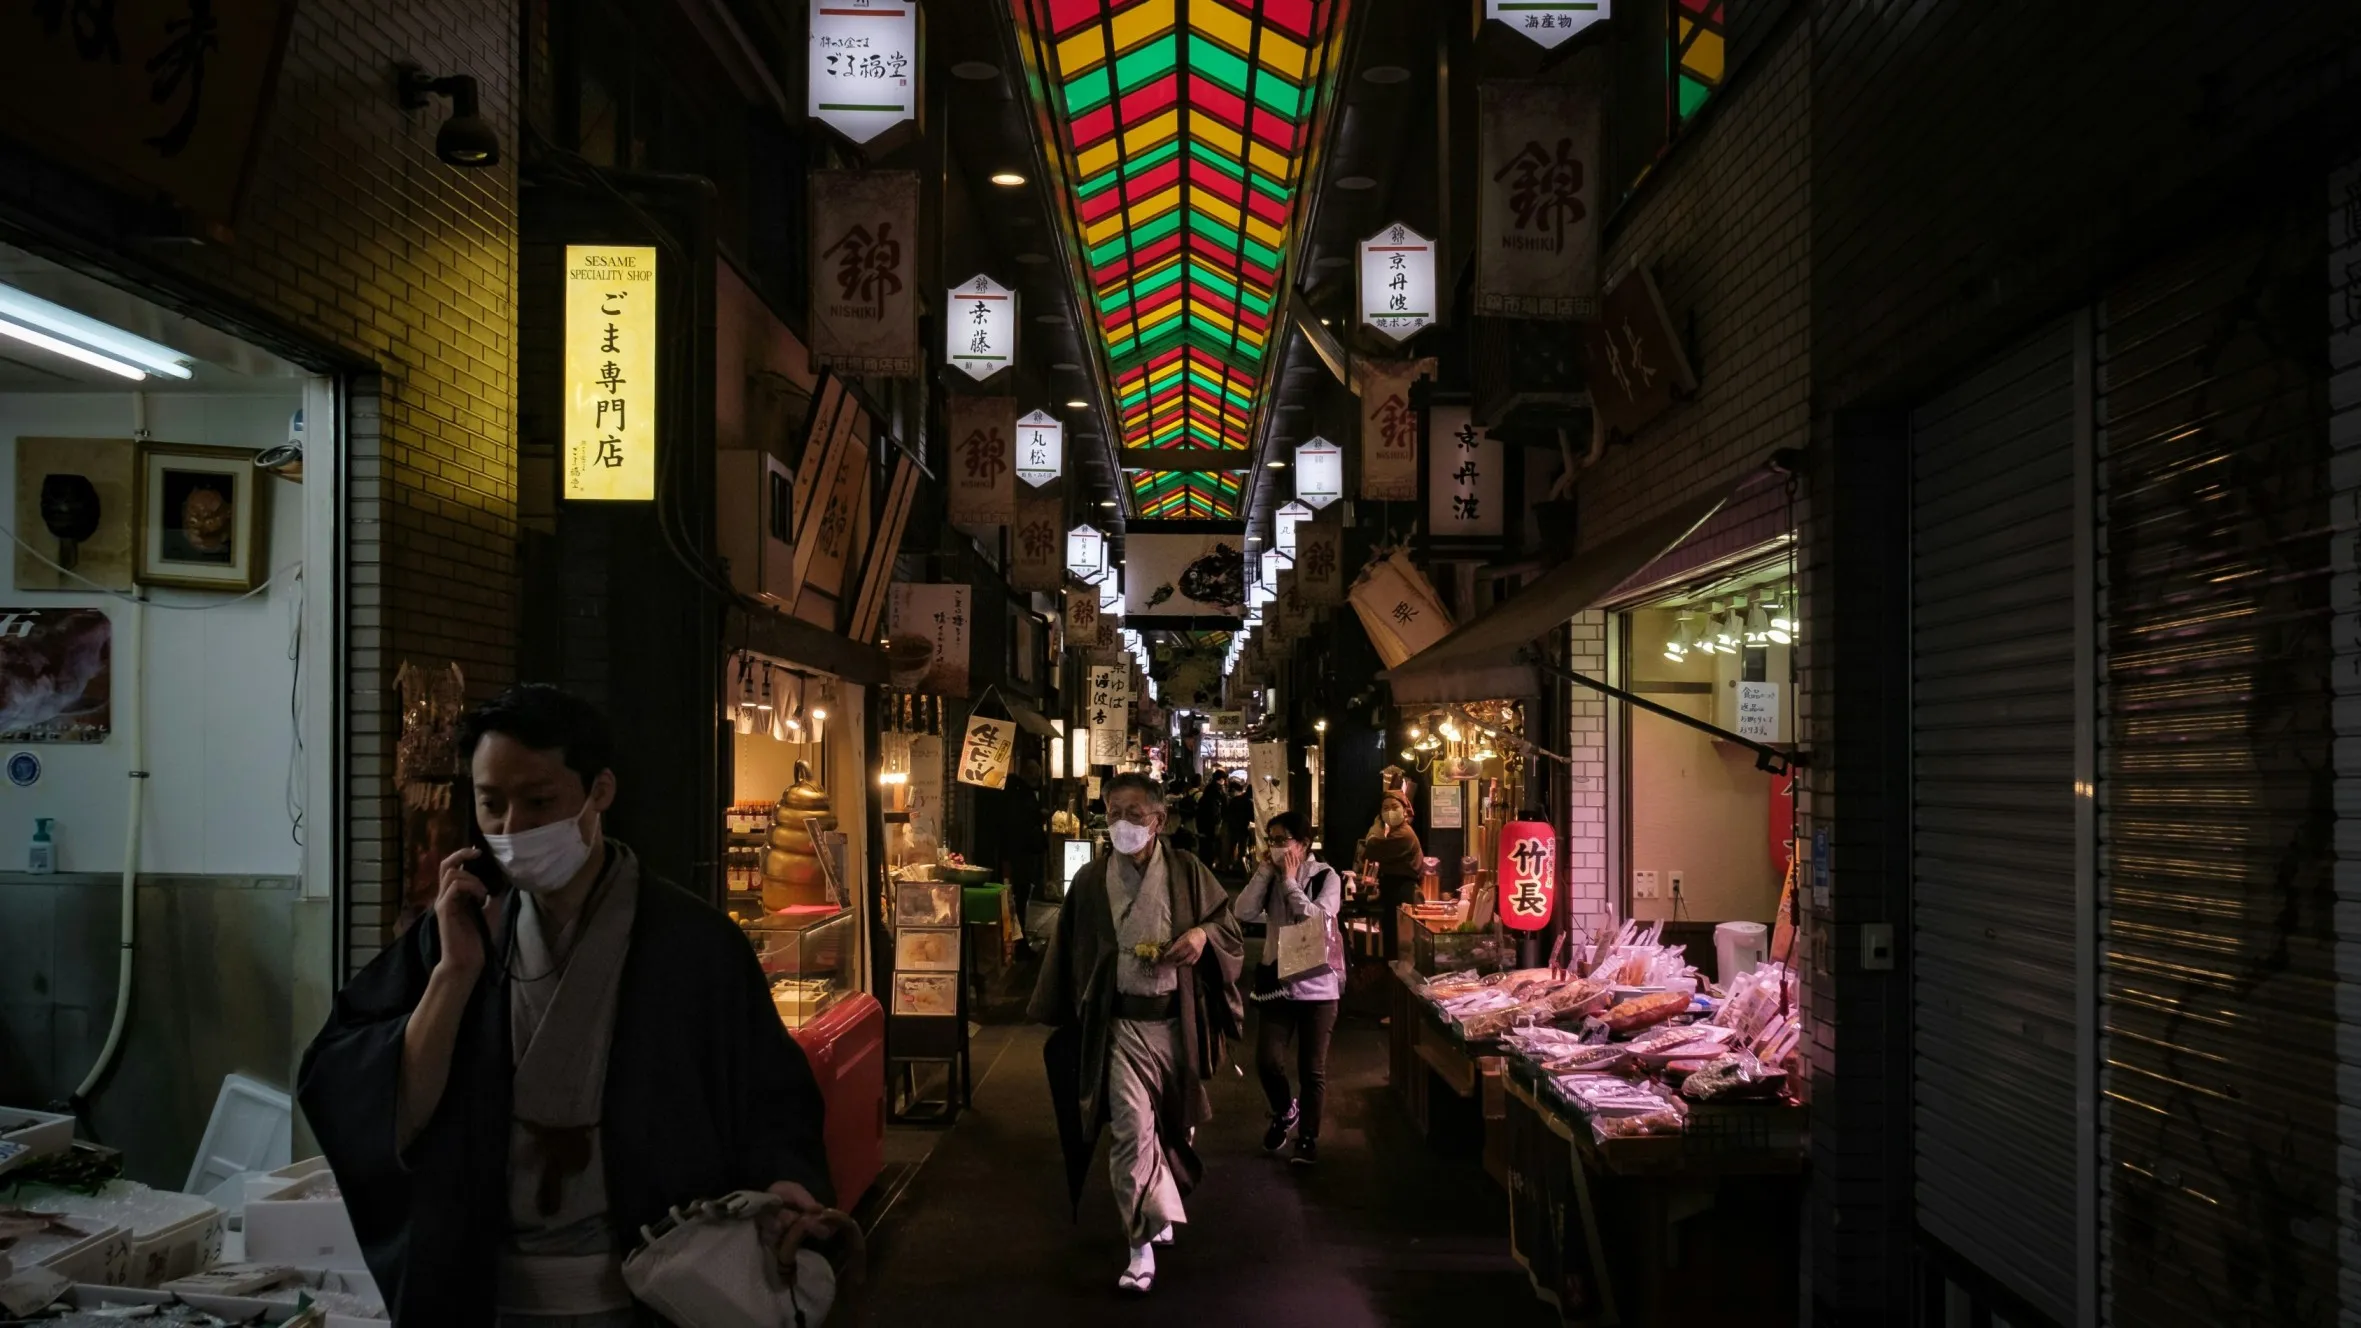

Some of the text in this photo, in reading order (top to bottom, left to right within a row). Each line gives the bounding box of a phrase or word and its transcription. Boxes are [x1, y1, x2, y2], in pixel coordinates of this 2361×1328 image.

[1524, 14, 1572, 28] 海産物
[826, 51, 908, 79] ごま福堂
[1494, 138, 1586, 255] 錦
[1502, 235, 1554, 251] NISHIKI
[570, 269, 653, 282] SPECIALITY SHOP
[584, 256, 636, 268] SESAME
[822, 222, 903, 322] 錦
[1388, 252, 1409, 311] 京丹波
[831, 305, 876, 319] NISHIKI
[593, 291, 628, 469] ごま専門店
[956, 427, 1007, 490] 錦
[1029, 430, 1047, 466] 丸松
[1019, 521, 1055, 566] 錦
[1069, 599, 1094, 629] 錦
[1391, 601, 1420, 628] 栗
[965, 724, 1000, 782] 生ビール
[1512, 840, 1548, 914] 竹長
